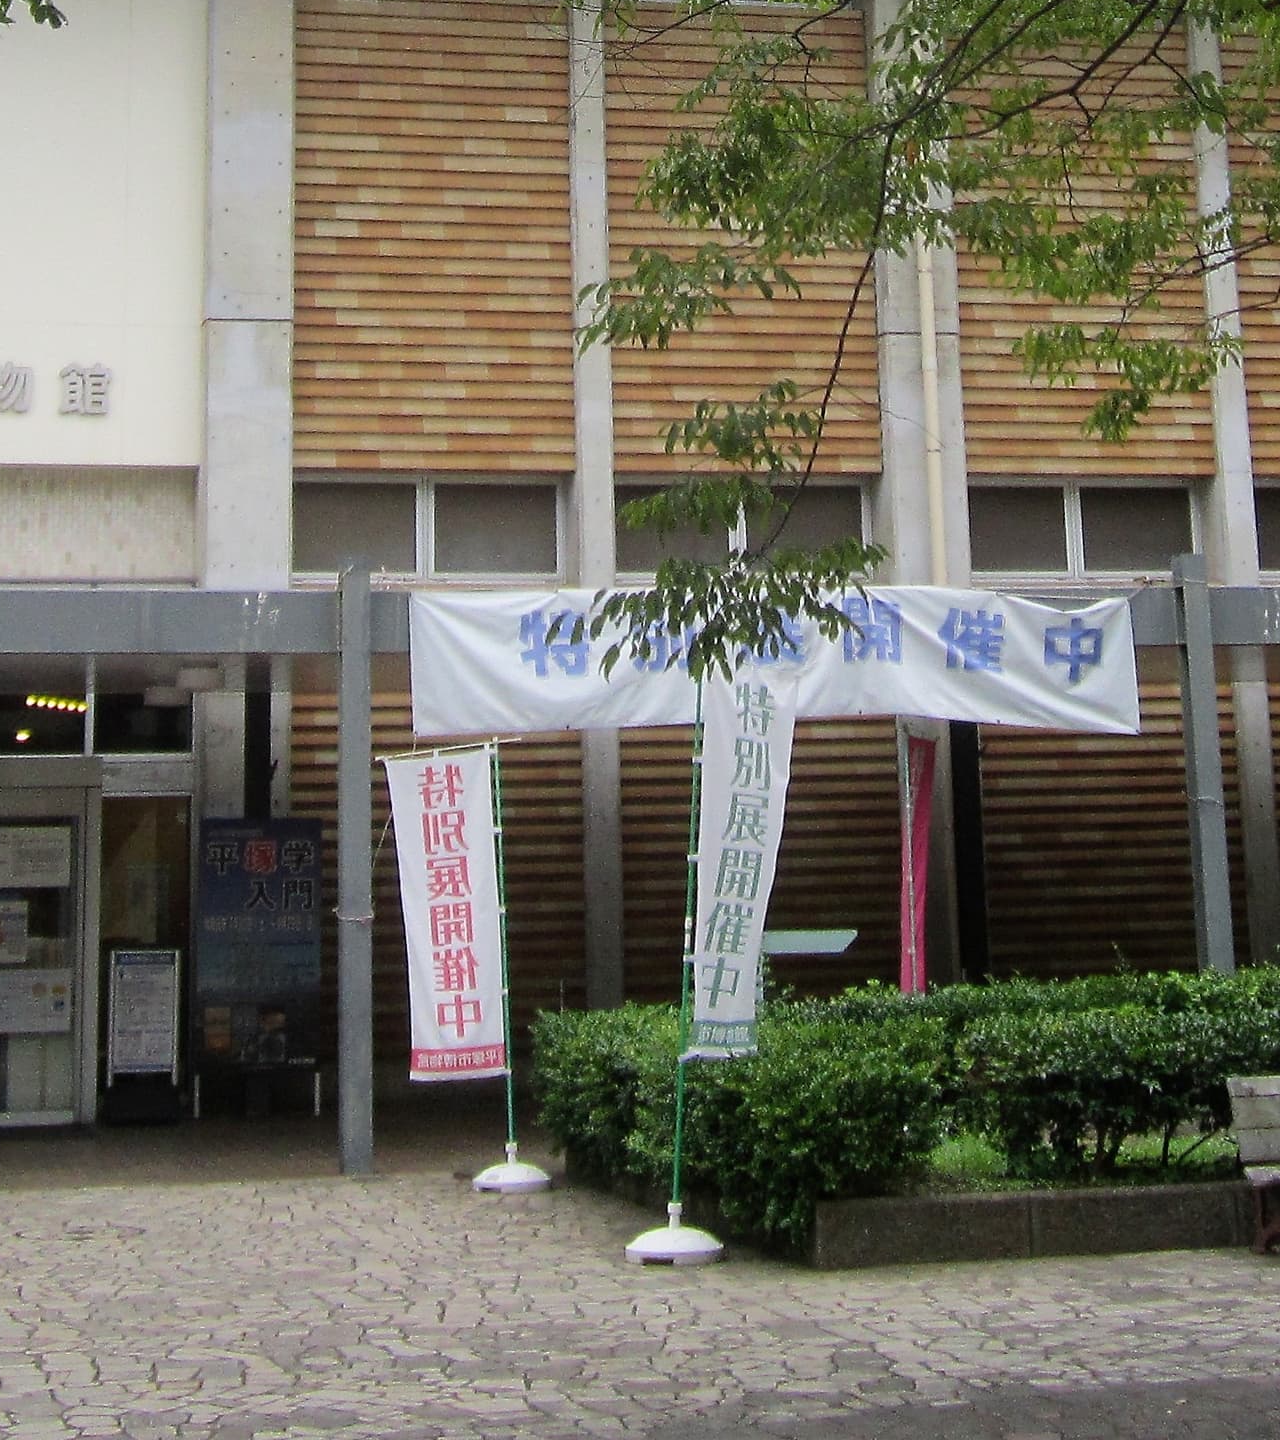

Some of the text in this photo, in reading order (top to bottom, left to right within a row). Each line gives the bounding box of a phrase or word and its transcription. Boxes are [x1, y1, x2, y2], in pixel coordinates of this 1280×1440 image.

[244, 878, 315, 912] 入門
[703, 684, 775, 1010] 特別展開催中
